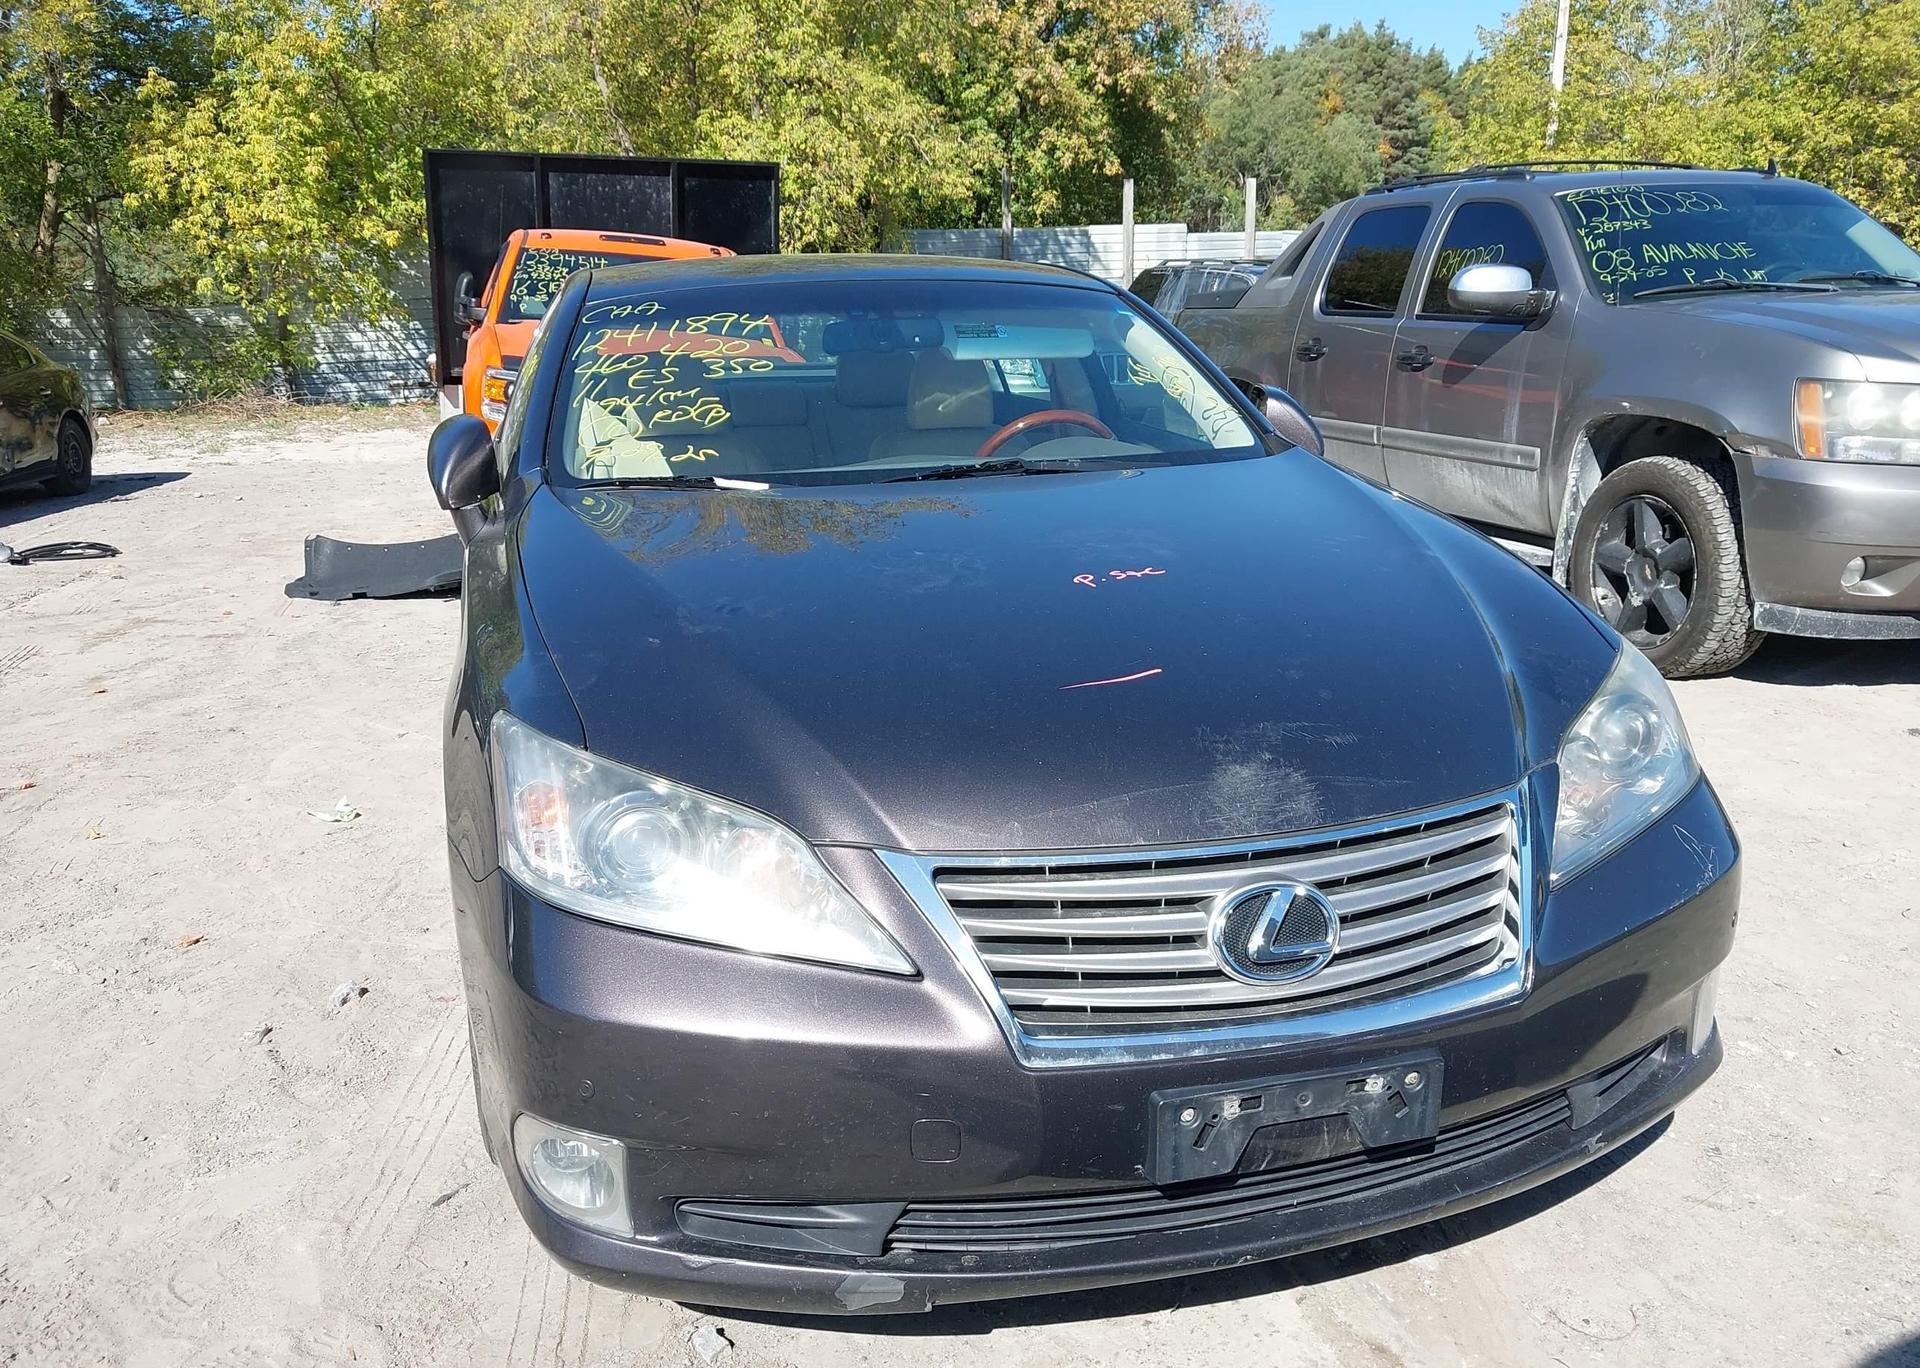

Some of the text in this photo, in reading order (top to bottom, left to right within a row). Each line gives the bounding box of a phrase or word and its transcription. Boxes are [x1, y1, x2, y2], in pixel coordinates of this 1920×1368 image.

[1642, 241, 1756, 265] AVALANCHE
[659, 338, 750, 367] 420
[628, 367, 680, 389] ES
[702, 358, 774, 378] 350
